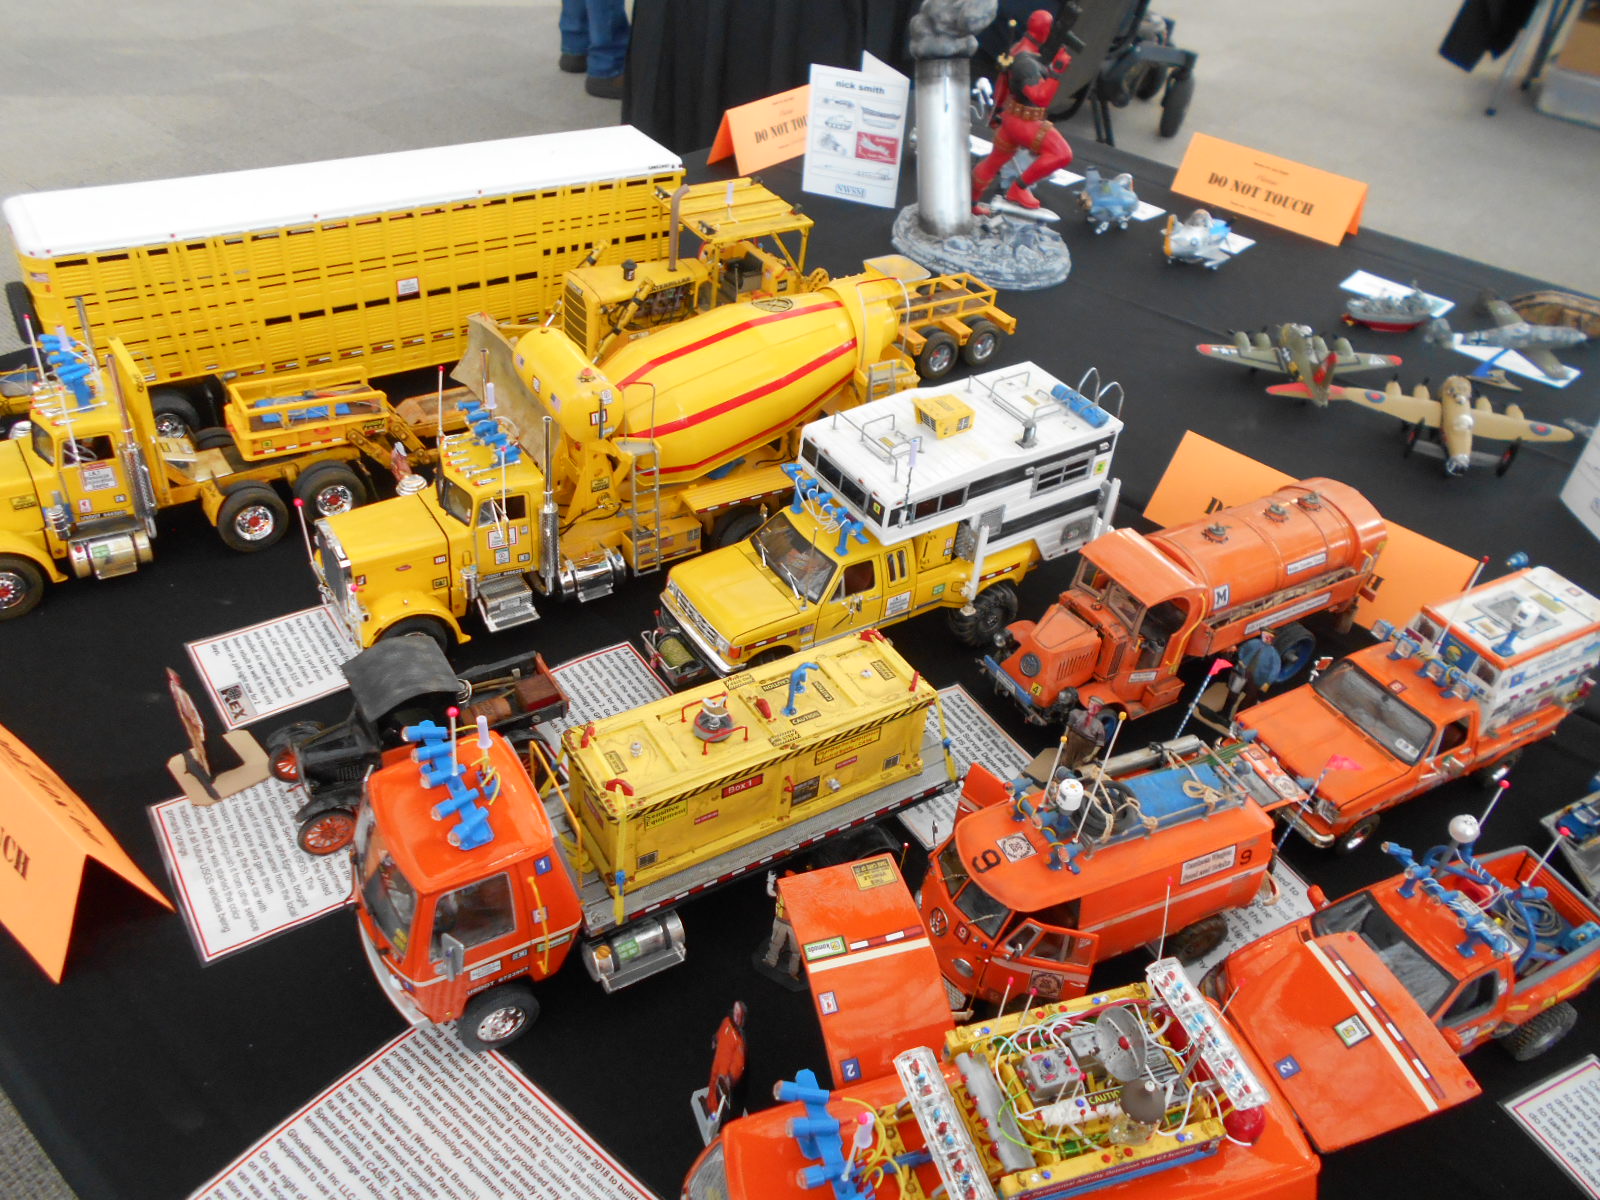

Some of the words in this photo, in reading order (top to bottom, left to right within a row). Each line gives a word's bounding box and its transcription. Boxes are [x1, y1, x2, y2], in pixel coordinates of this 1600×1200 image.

[835, 79, 855, 90] nick
[859, 82, 885, 95] smith
[754, 124, 769, 144] DO
[771, 120, 789, 139] NOT
[1208, 172, 1228, 189] DO
[1230, 180, 1262, 198] NOT
[1264, 188, 1315, 217] TOUCH
[1216, 589, 1227, 605] M
[1032, 685, 1040, 694] 4
[791, 711, 821, 725] CAUTION
[646, 805, 680, 820] Sensitive
[728, 783, 746, 794] Box
[646, 808, 686, 827] Equipment
[0, 827, 31, 881] CH
[540, 860, 547, 870] 1
[1239, 849, 1253, 866] 9
[958, 926, 968, 939] 9
[846, 1063, 856, 1077] 2
[1279, 1061, 1294, 1074] 2
[381, 1055, 409, 1083] decided
[405, 1080, 414, 1090] to
[412, 1088, 442, 1116] contract
[439, 1115, 453, 1128] out
[450, 1126, 464, 1140] the
[460, 1138, 503, 1178] paranormal
[399, 1042, 438, 1077] paranormal
[433, 1076, 473, 1113] phenomena
[471, 1112, 488, 1126] still
[484, 1124, 503, 1142] have
[501, 1142, 516, 1154] not
[511, 1153, 550, 1187] produced
[410, 1034, 425, 1048] had
[421, 1048, 460, 1082] quadrupled
[457, 1080, 466, 1090] in
[464, 1088, 477, 1100] the
[474, 1099, 506, 1128] previous
[510, 1132, 537, 1159] months.
[538, 1158, 572, 1192] Sensitive
[443, 1036, 460, 1051] vans
[458, 1050, 474, 1064] and
[471, 1061, 482, 1071] fit
[479, 1069, 497, 1087] them
[496, 1086, 514, 1101] with
[510, 1100, 548, 1135] equipment
[545, 1132, 555, 1142] to
[553, 1141, 568, 1154] aid
[565, 1151, 574, 1161] in
[573, 1159, 587, 1173] the
[585, 1170, 617, 1200] detectio
[444, 1051, 465, 1072] Police
[463, 1071, 481, 1087] calls
[479, 1086, 515, 1121] emanating
[513, 1117, 531, 1135] from
[529, 1134, 543, 1147] the
[542, 1145, 570, 1173] Tacoma
[1088, 1089, 1121, 1105] CAUTIO
[303, 1114, 342, 1156] temperature
[340, 1154, 361, 1176] range
[358, 1174, 371, 1184] of
[313, 1105, 343, 1136] Spectral
[339, 1133, 365, 1161] Entities
[335, 1090, 348, 1103] the
[346, 1100, 362, 1117] first
[359, 1116, 373, 1130] van
[371, 1129, 387, 1144] was
[384, 1142, 410, 1167] almost
[406, 1165, 439, 1199] complete
[335, 1109, 352, 1124] bed
[348, 1123, 368, 1142] truck
[364, 1140, 374, 1150] to
[372, 1149, 391, 1169] carry
[389, 1166, 404, 1183] any
[346, 1082, 360, 1097] two
[375, 1112, 397, 1135] These
[394, 1133, 418, 1156] would
[414, 1153, 426, 1165] be
[423, 1163, 437, 1177] the
[379, 1099, 413, 1134] Industries
[430, 1151, 453, 1174] Coast
[412, 1104, 464, 1160] Parapsychology
[416, 1073, 434, 1090] With
[430, 1088, 444, 1102] law
[442, 1101, 485, 1142] enforcement
[482, 1139, 512, 1169] budgets
[510, 1168, 537, 1196] already
[487, 1062, 498, 1072] of
[494, 1068, 518, 1092] Seattle
[517, 1091, 532, 1105] was
[531, 1104, 567, 1137] contacted
[564, 1133, 573, 1144] in
[572, 1141, 591, 1161] June
[590, 1158, 611, 1177] 2018
[608, 1174, 618, 1185] to
[616, 1182, 639, 1200] build
[247, 1160, 258, 1171] on
[256, 1168, 270, 1183] the
[258, 1149, 271, 1164] On
[268, 1160, 282, 1175] the
[278, 1174, 300, 1194] night
[275, 1137, 312, 1174] equipment
[307, 1171, 318, 1182] to
[315, 1180, 330, 1196] use
[286, 1127, 330, 1175] Ghostbusters
[327, 1171, 340, 1186] Inc
